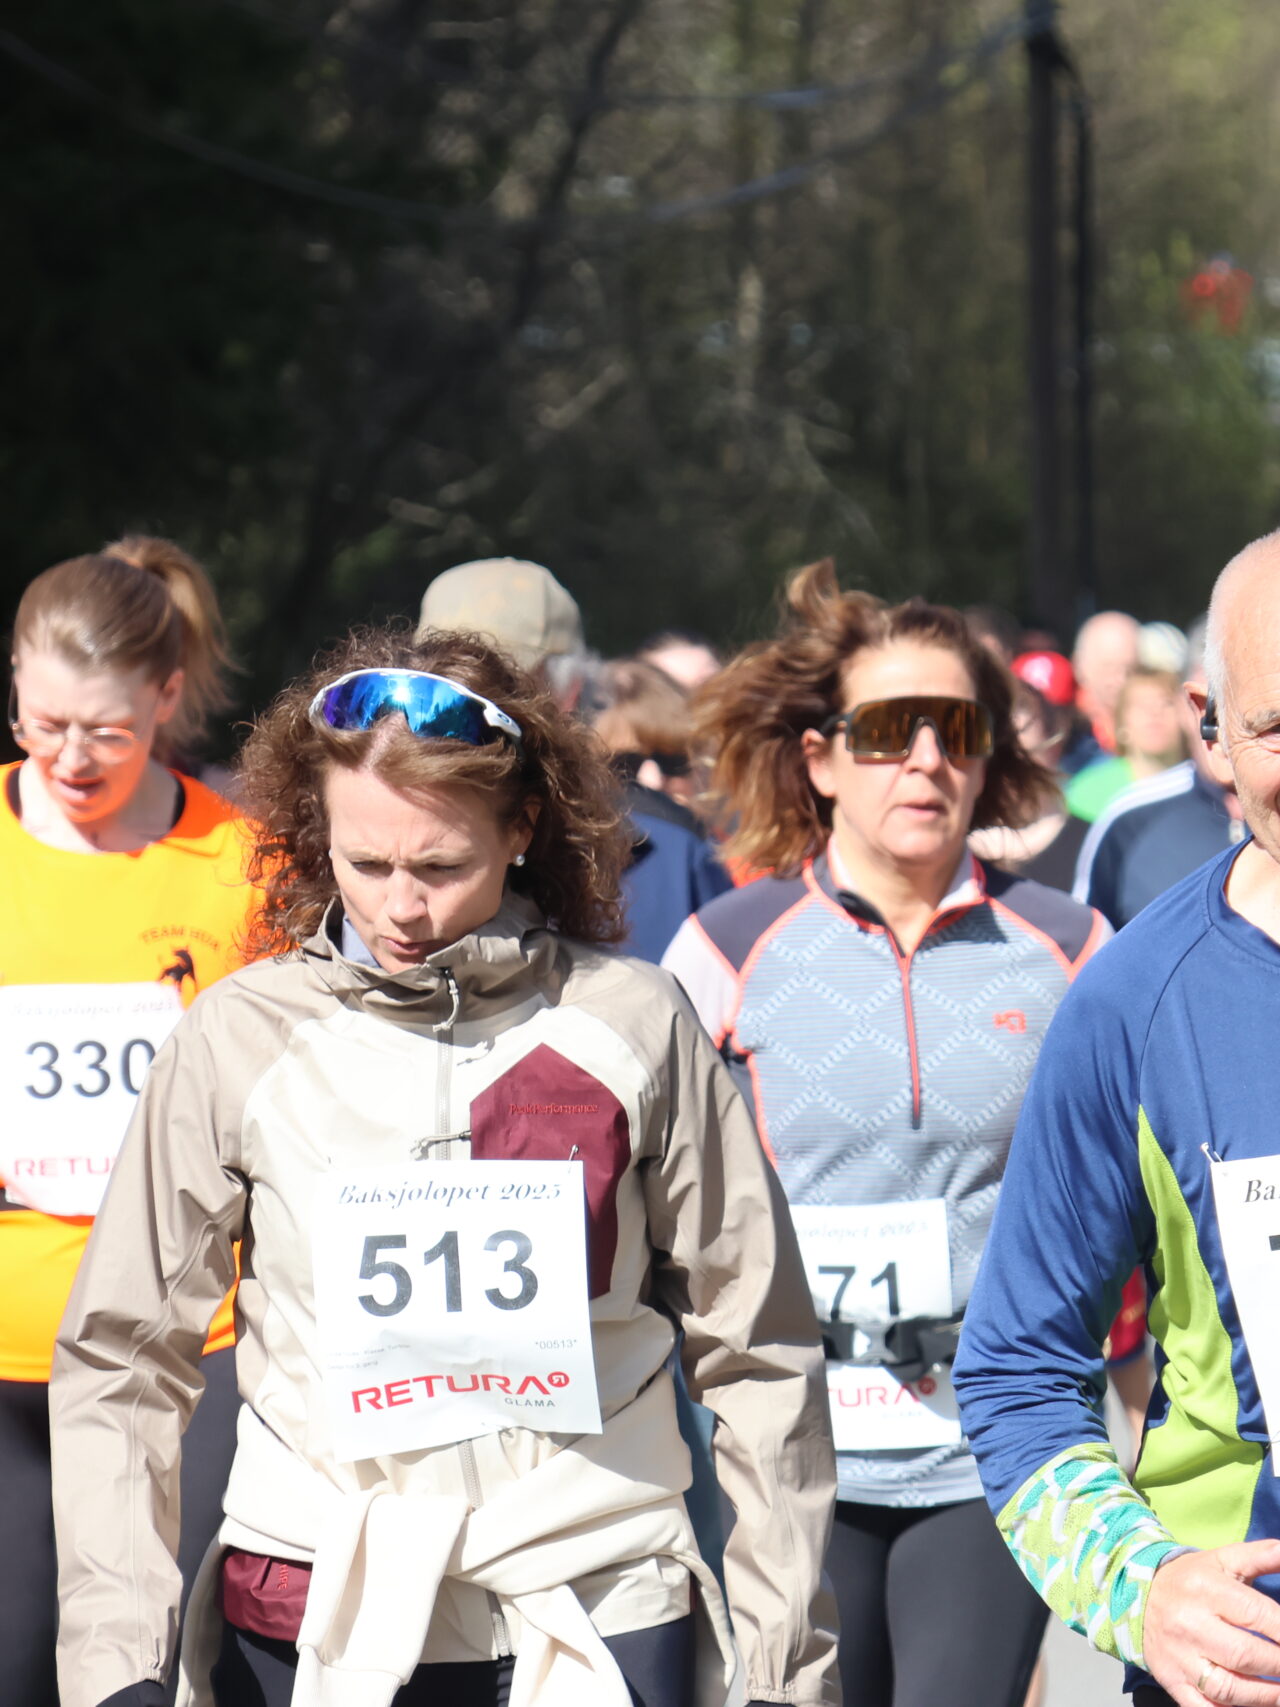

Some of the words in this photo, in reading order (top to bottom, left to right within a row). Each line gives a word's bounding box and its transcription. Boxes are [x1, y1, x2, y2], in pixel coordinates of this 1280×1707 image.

[14, 1156, 117, 1176] RETU
[500, 1183, 562, 1201] 2025
[357, 1229, 538, 1317] 513
[351, 1373, 551, 1413] RETURA
